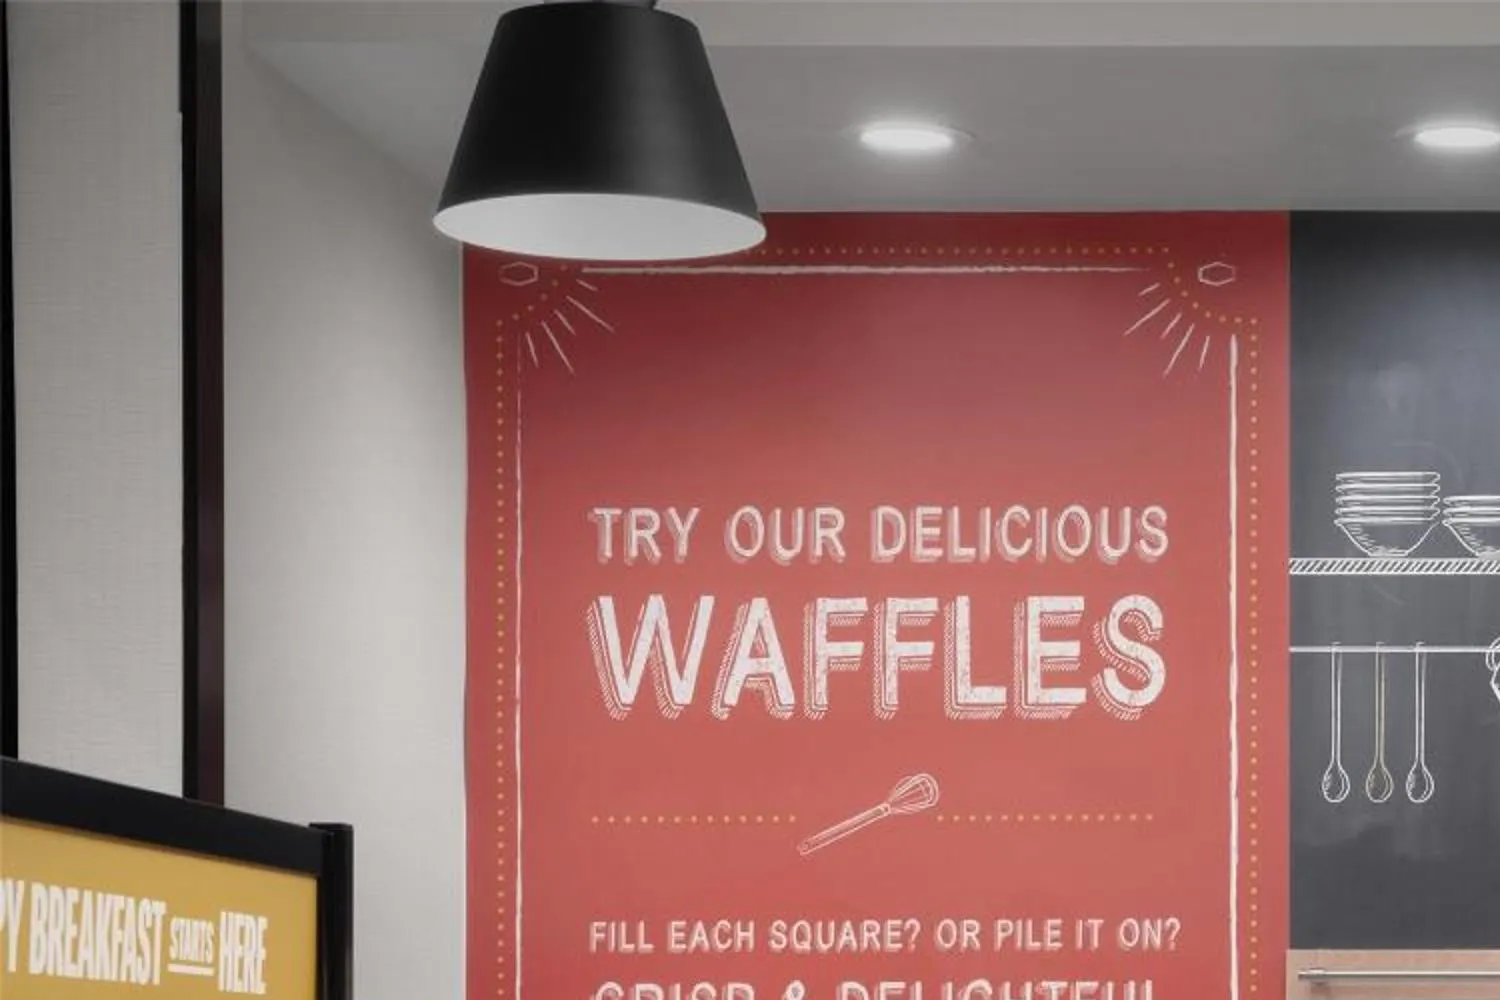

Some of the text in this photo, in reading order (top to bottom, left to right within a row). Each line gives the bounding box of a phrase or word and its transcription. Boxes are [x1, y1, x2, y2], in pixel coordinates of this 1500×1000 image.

[588, 505, 1169, 566] TRY OUR DELICIOUS
[587, 594, 1166, 720] WAFFLES
[29, 882, 167, 986] BREAKFAST
[170, 917, 214, 964] STARTS
[218, 911, 268, 995] HERE
[590, 917, 1181, 953] FILL EACH SQUARE? OR PILE IT ON?
